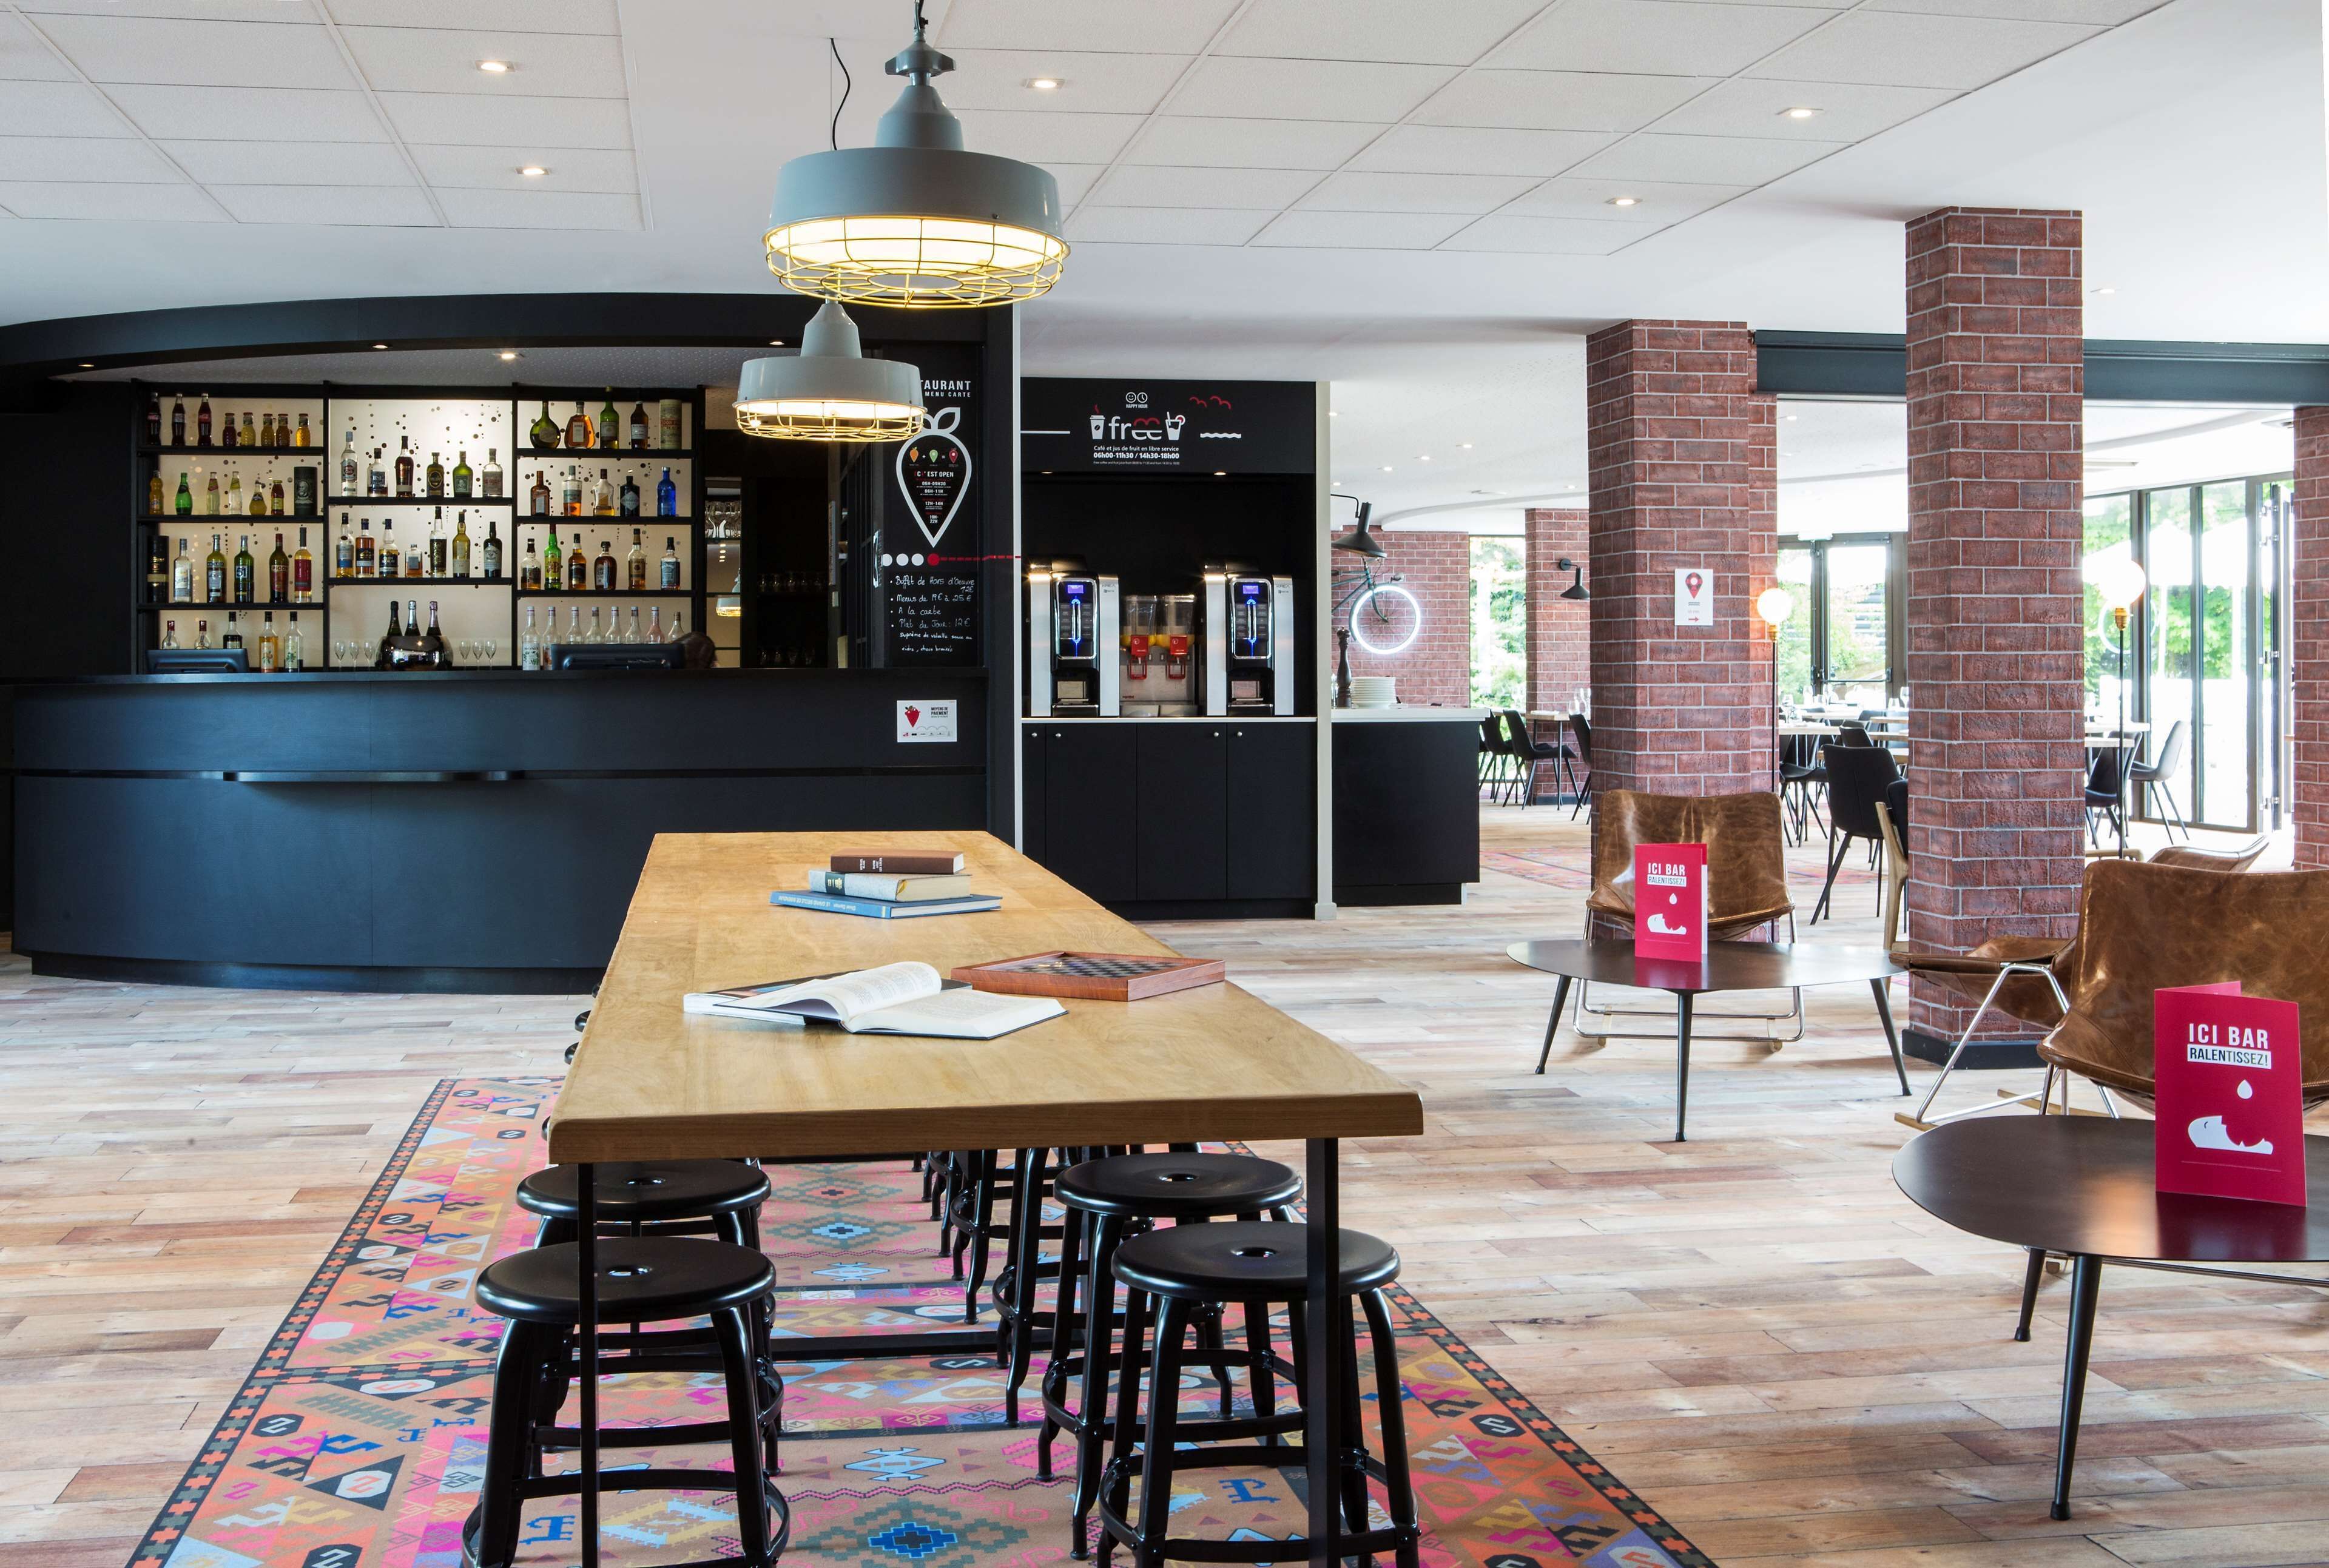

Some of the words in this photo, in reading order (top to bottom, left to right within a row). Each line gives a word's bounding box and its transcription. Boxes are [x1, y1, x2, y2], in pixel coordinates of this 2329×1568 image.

[1108, 416, 1162, 440] free
[237, 567, 247, 578] 51
[917, 576, 925, 585] de
[929, 576, 945, 585] Hors
[920, 605, 942, 615] carte
[899, 618, 913, 628] Plat
[919, 620, 929, 628] du
[1648, 863, 1661, 875] ICI
[1665, 864, 1685, 876] BAR
[1648, 877, 1685, 885] RALENTISSEZ!
[2189, 1023, 2217, 1045] ICI
[2228, 1026, 2268, 1049] BAR
[2189, 1048, 2268, 1066] RALENTISSEZ!
